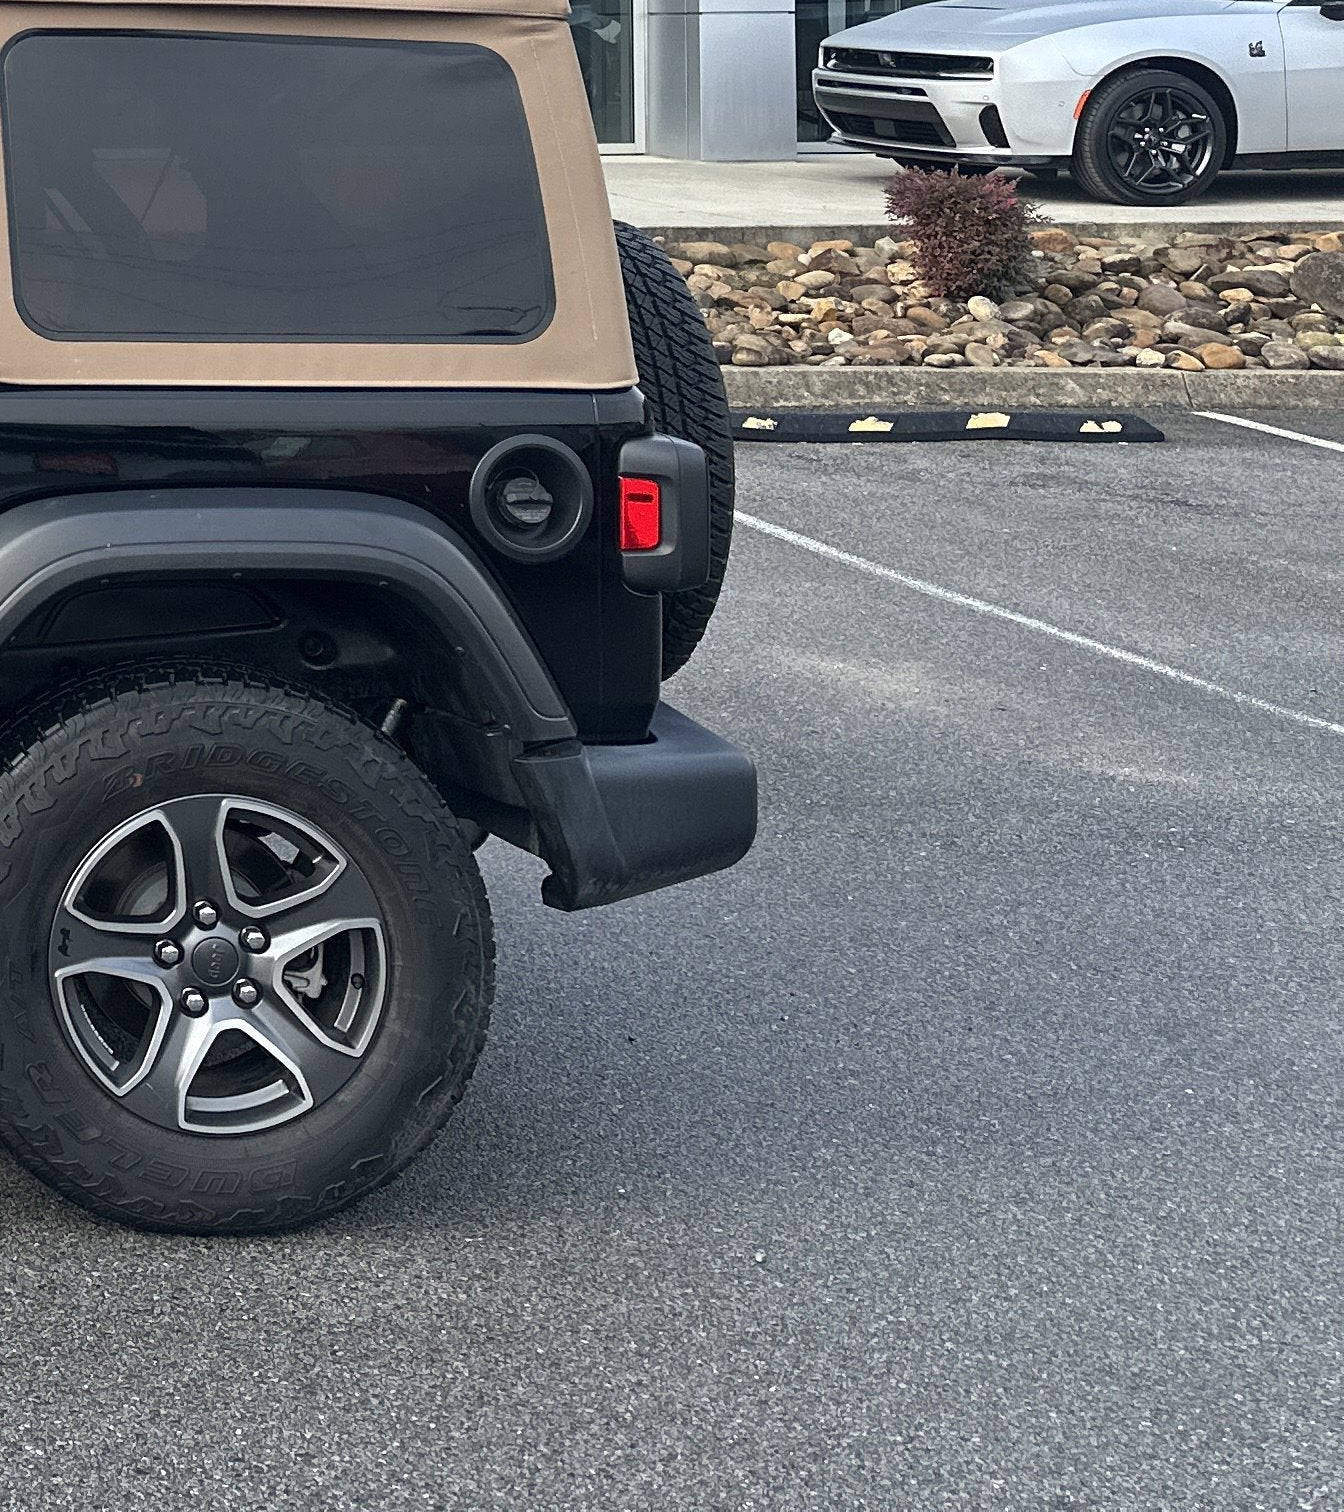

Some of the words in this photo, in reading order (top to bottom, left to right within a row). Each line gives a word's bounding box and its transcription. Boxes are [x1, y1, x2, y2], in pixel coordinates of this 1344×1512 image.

[101, 742, 442, 928] BRIDGESTONE
[207, 943, 226, 978] Jeep
[24, 1061, 299, 1194] DUELER
